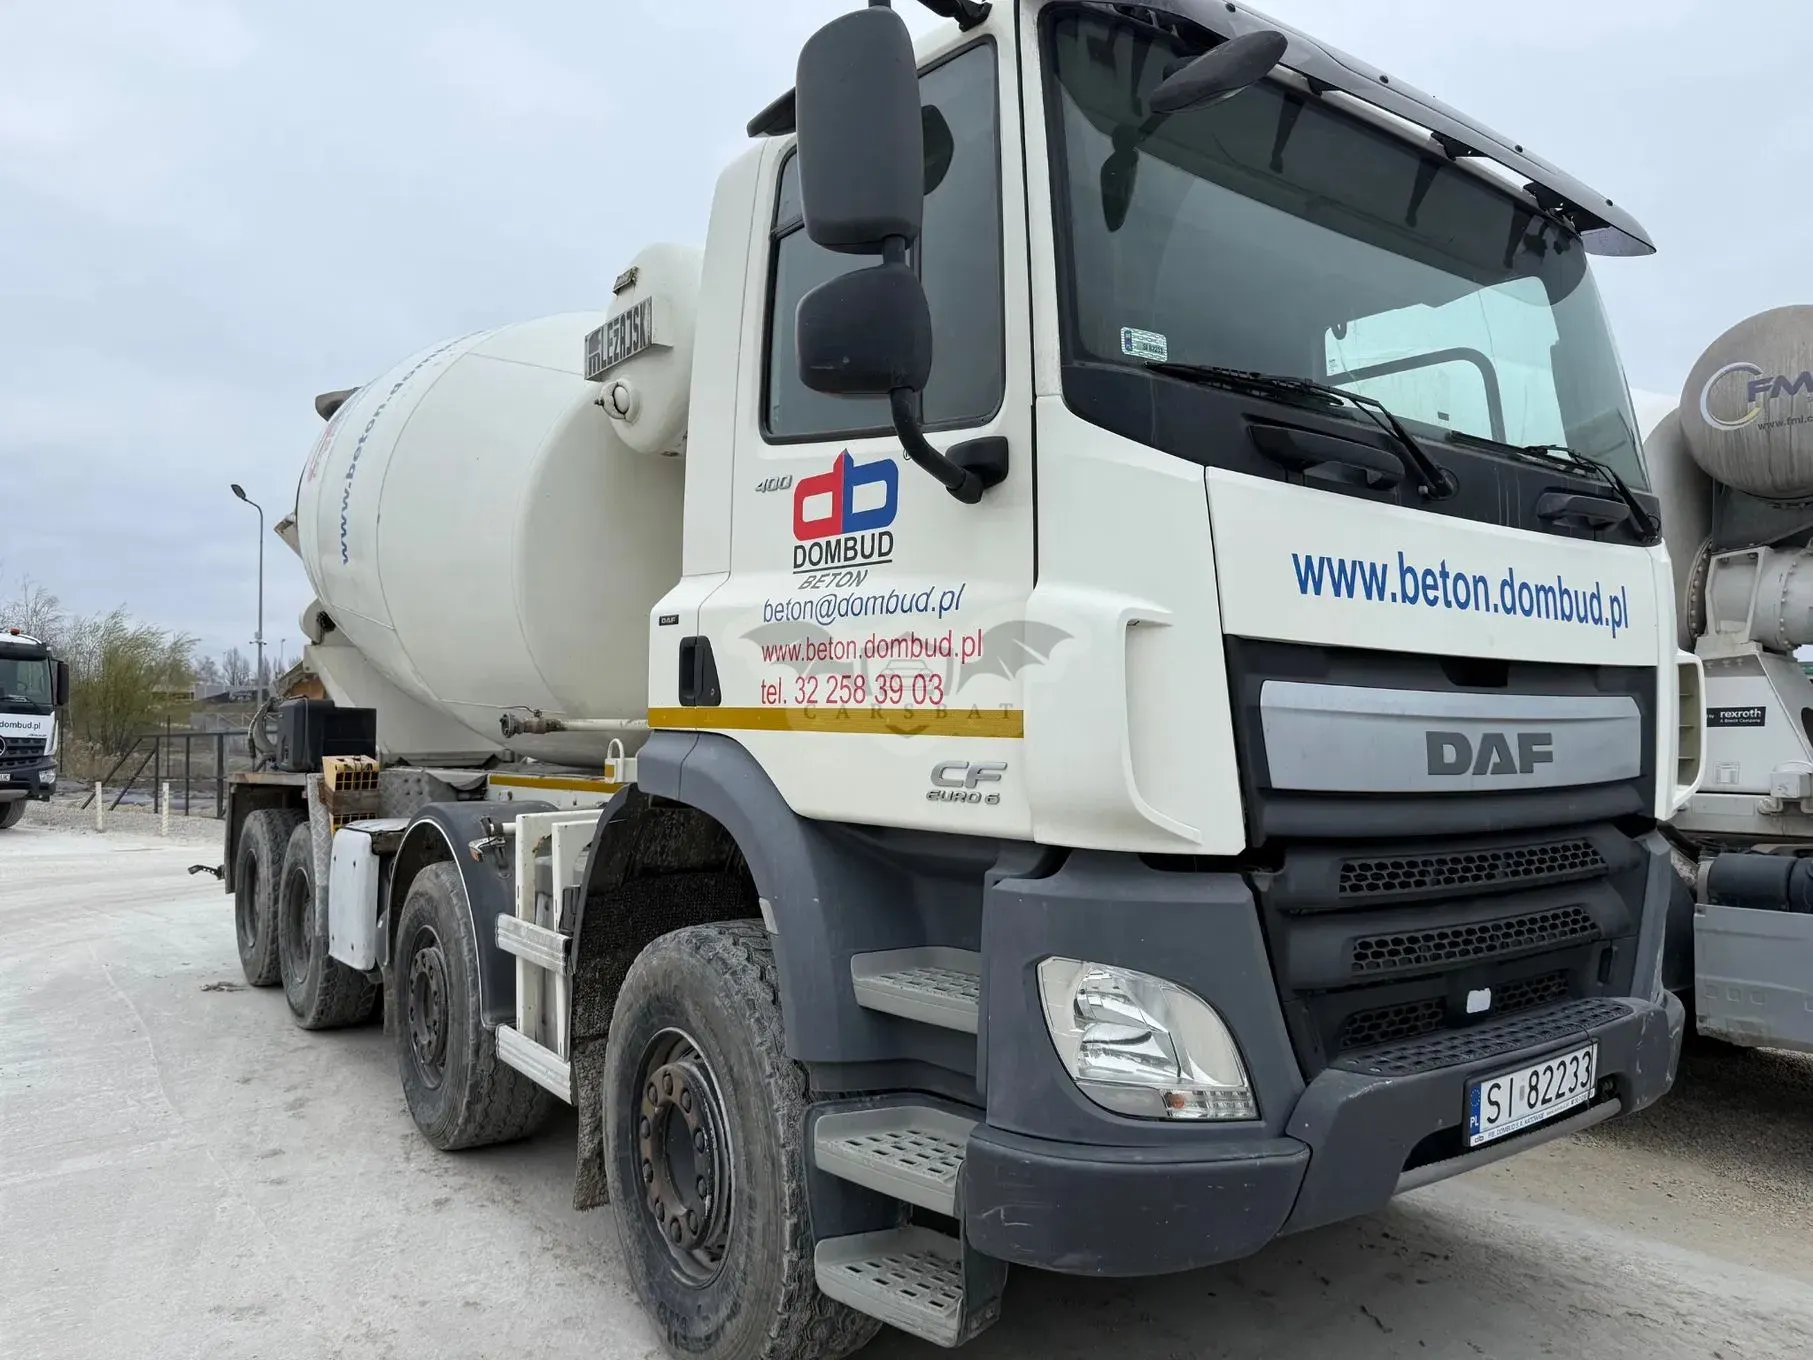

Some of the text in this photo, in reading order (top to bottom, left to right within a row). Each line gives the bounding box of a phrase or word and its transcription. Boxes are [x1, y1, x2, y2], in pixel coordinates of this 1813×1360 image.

[755, 475, 793, 493] 400
[793, 531, 894, 569] DOMBUD
[798, 569, 868, 589] BETON
[1292, 551, 1629, 638] www.beton.dombud.pl
[661, 616, 677, 624] DAF
[763, 583, 966, 626] beton@dombud.pl
[761, 629, 982, 664] www.beton.dombud.pl
[761, 673, 944, 706] tel. 32 258 39 03
[1720, 708, 1761, 718] rexroth
[1425, 730, 1553, 775] DAF
[930, 760, 1007, 789] CF
[926, 789, 1000, 805] EURO 6
[1487, 1050, 1591, 1124] SI 82233
[1470, 1116, 1479, 1128] PL
